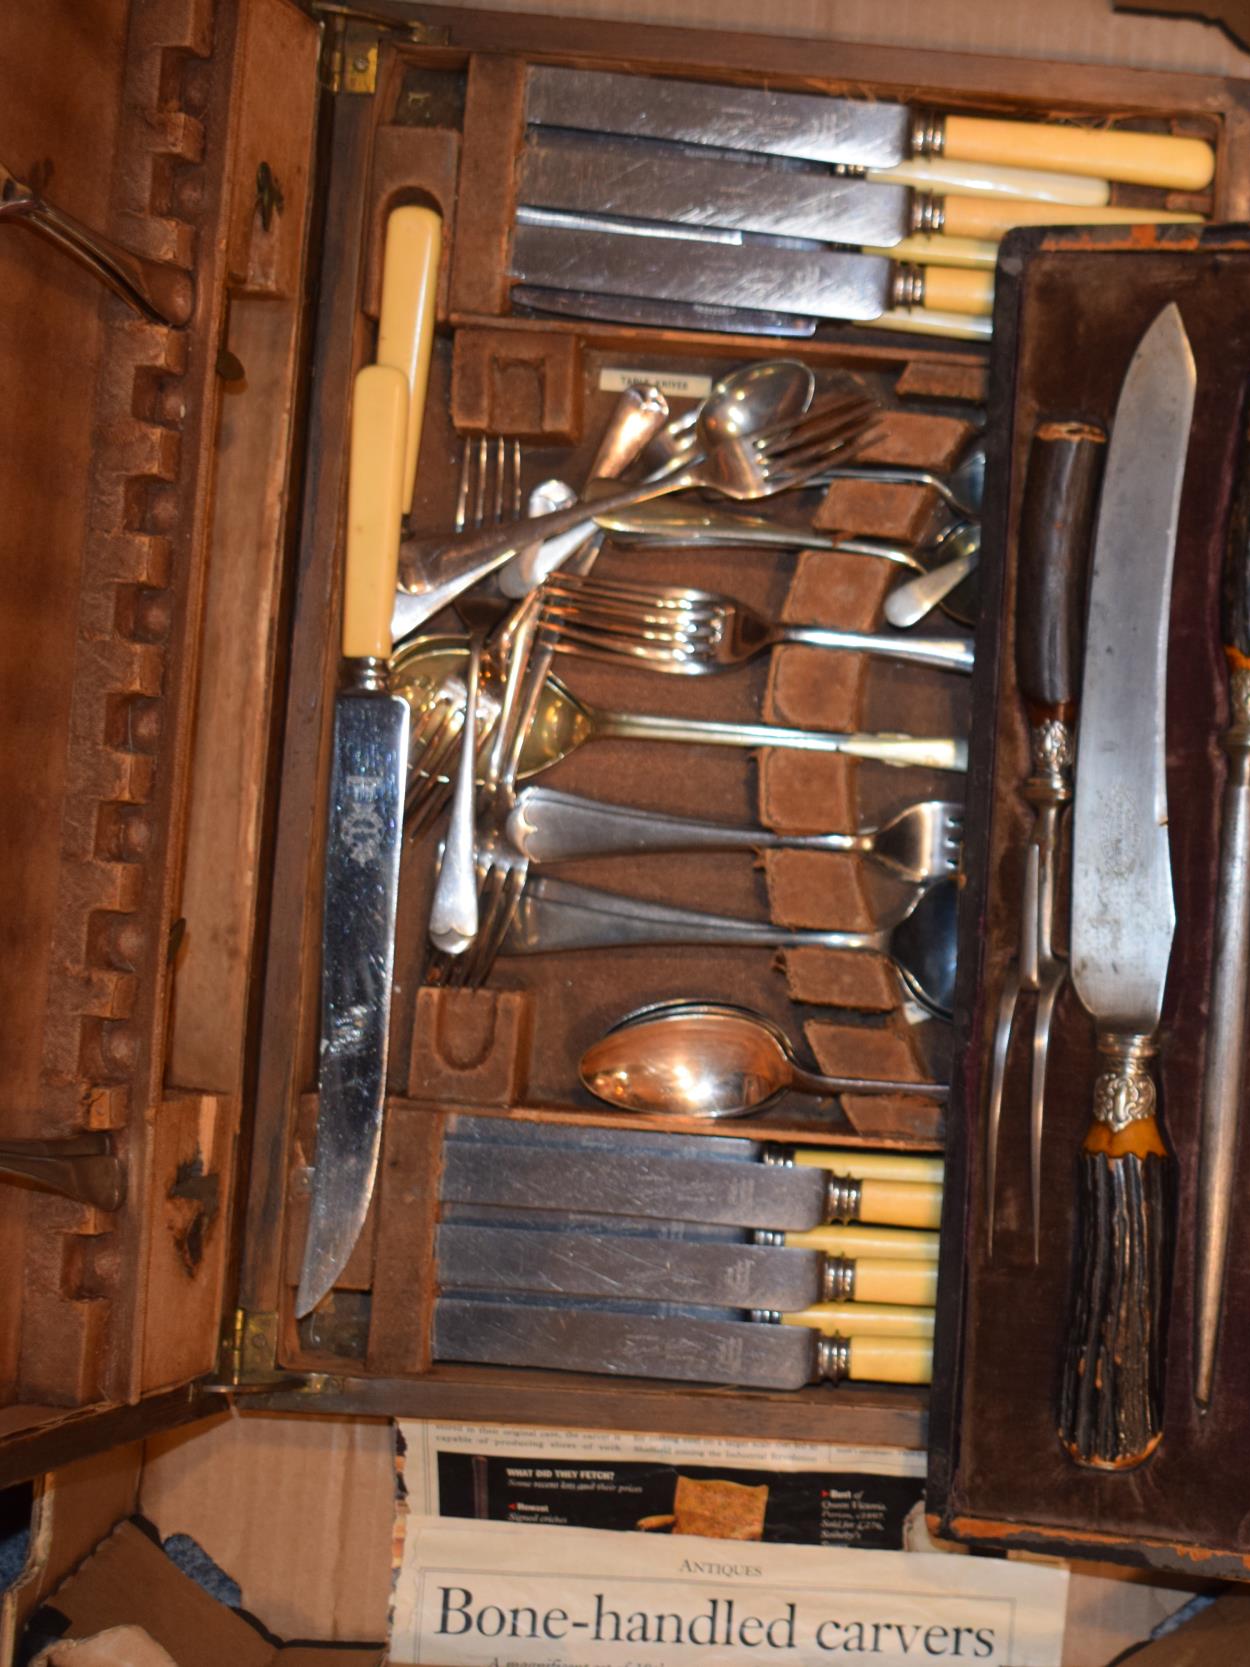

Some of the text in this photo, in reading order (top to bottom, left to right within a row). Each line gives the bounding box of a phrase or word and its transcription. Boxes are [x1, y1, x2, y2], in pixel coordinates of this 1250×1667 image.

[435, 1434, 472, 1446] capable
[478, 1437, 488, 1445] of
[494, 1438, 543, 1449] producing
[506, 1468, 616, 1481] WHAT DID THEY FETCH?
[507, 1479, 532, 1488] Some
[533, 1481, 559, 1489] recent
[577, 1482, 597, 1491] and
[597, 1482, 617, 1492] their
[618, 1484, 644, 1495] prices
[678, 1558, 763, 1579] ANTIQUES
[435, 1585, 996, 1659] Bone-handled carvers
